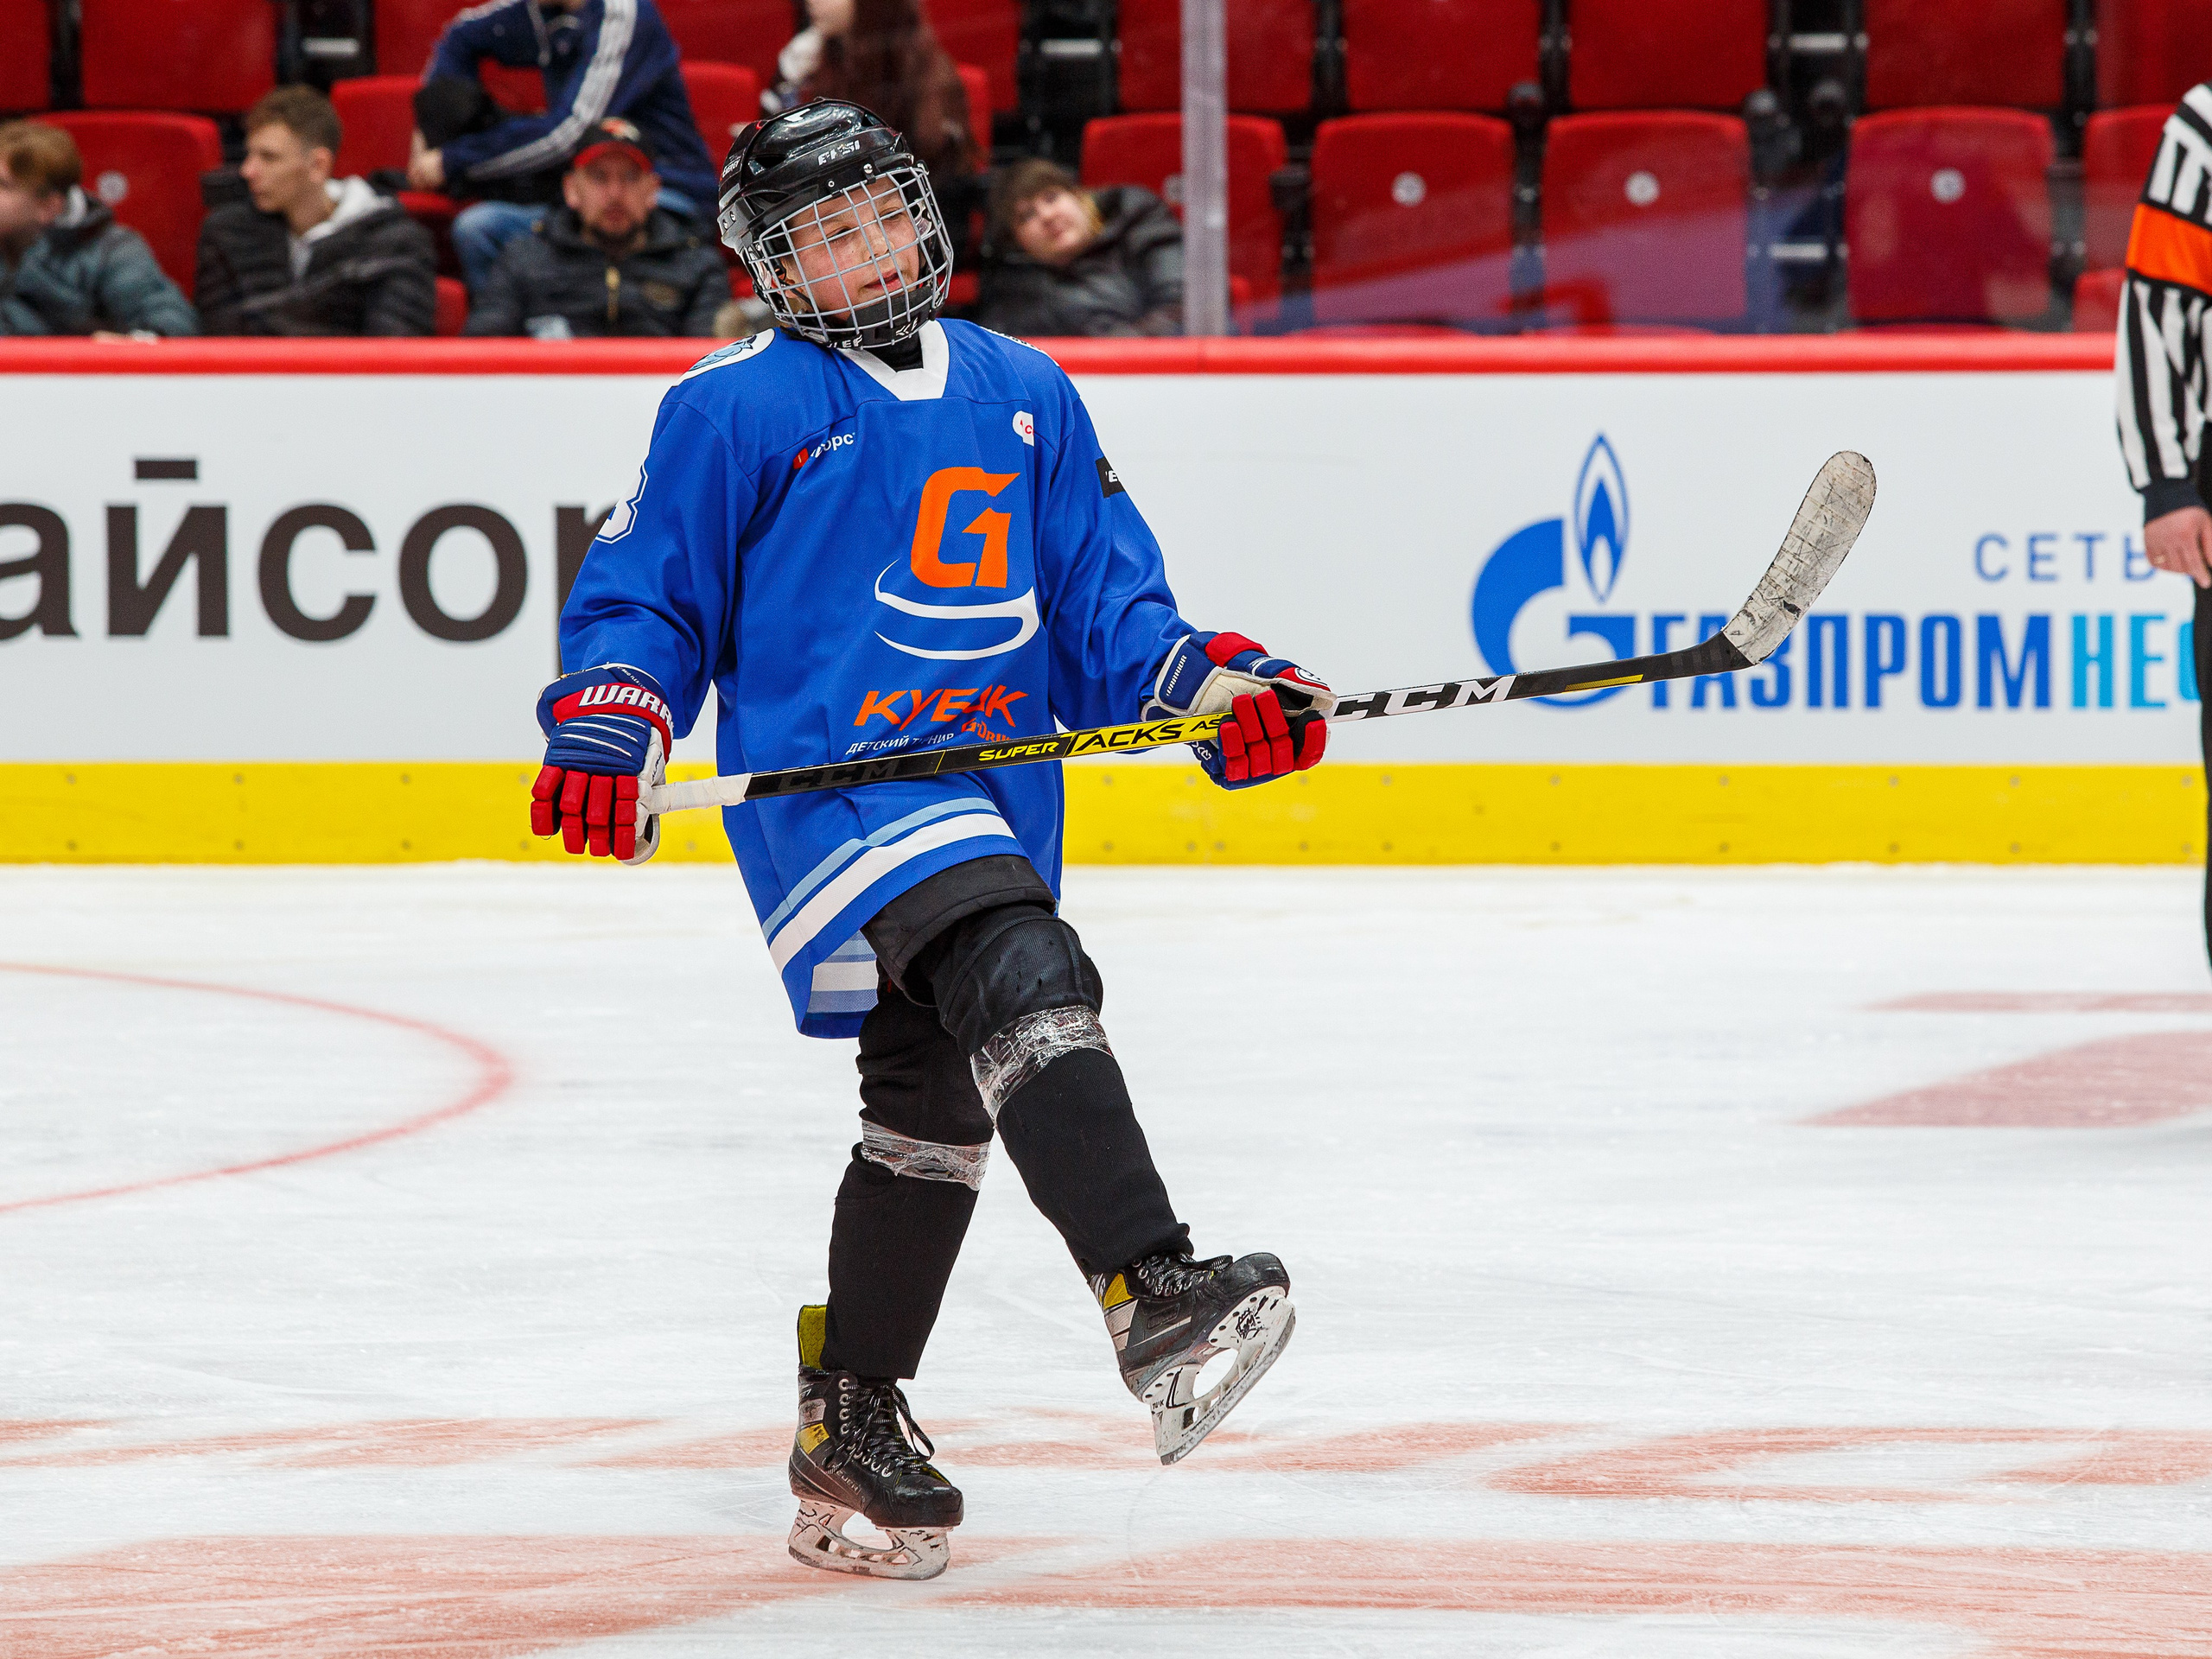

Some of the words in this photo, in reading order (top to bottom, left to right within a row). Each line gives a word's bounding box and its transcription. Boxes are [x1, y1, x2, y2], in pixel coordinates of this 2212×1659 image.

[1975, 532, 2156, 582] СЕТЬ
[578, 684, 674, 732] WARR
[1328, 676, 1518, 723] CCM
[777, 759, 900, 792] CCM
[978, 741, 1059, 762] SUPER
[1061, 721, 1185, 758] TACKS
[845, 734, 909, 755] ДЕТСКИЙ
